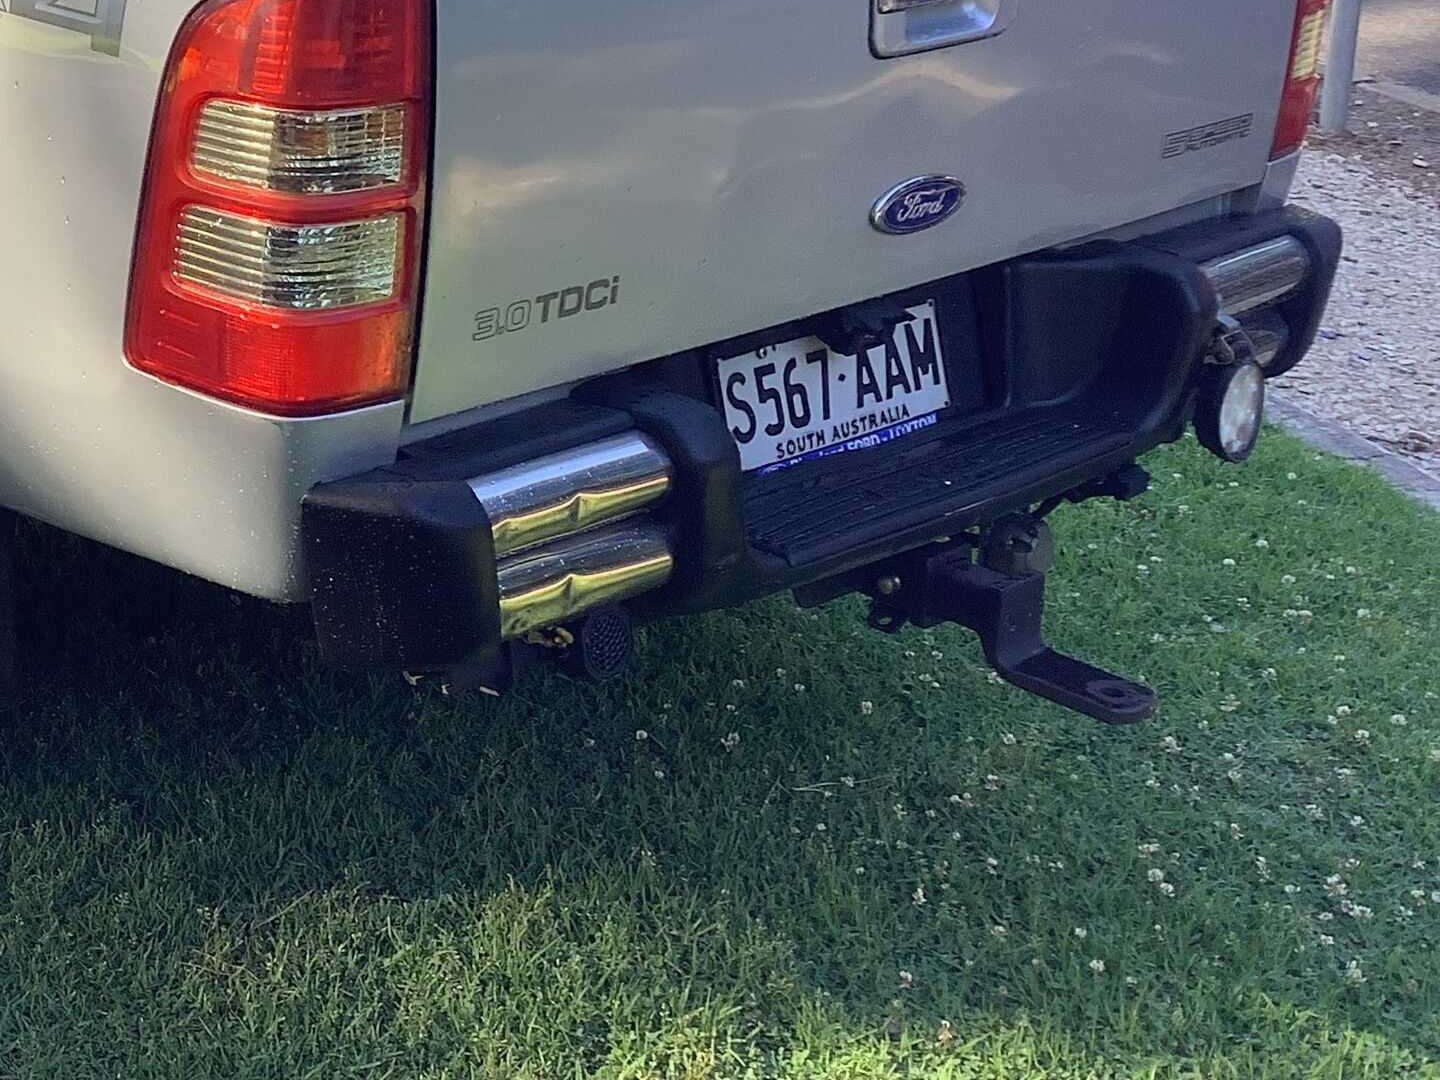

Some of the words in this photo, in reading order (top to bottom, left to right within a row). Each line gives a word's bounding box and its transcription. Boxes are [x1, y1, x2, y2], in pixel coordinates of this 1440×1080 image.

[897, 187, 952, 222] Ford
[775, 429, 826, 459] SOUTH
[831, 404, 910, 442] AUSTRALIA
